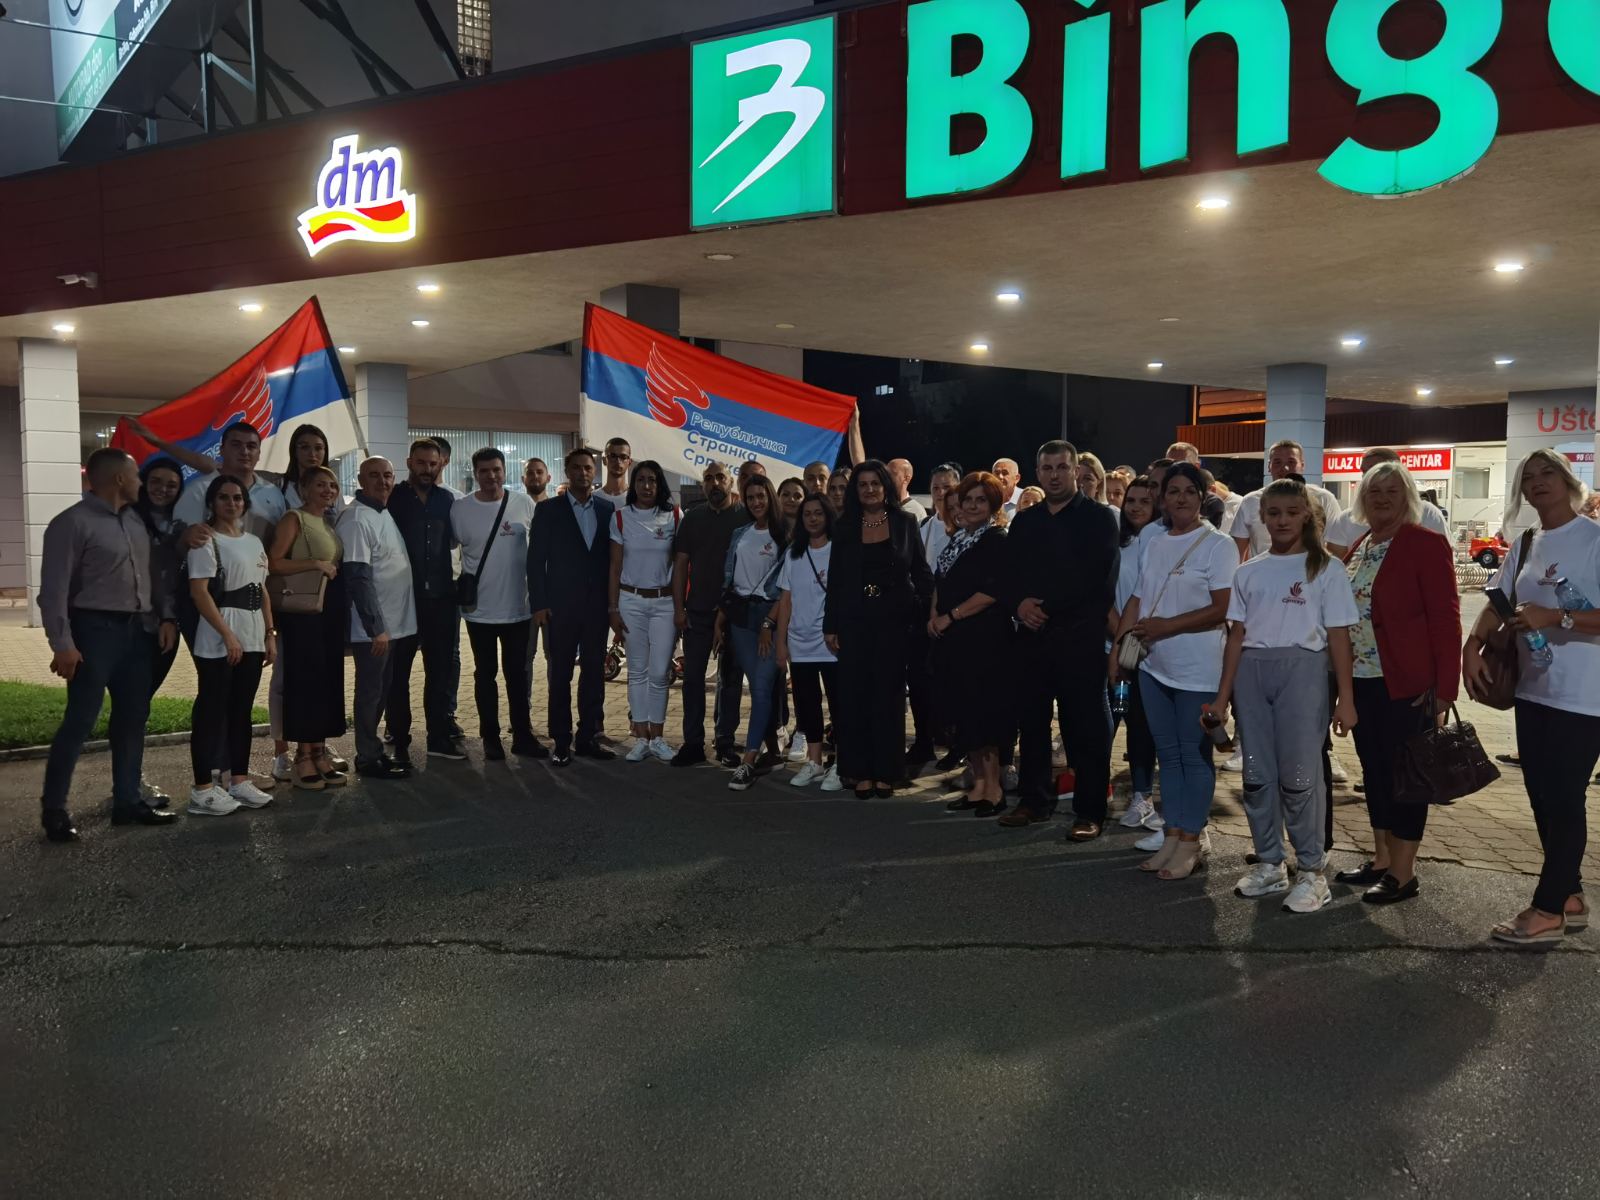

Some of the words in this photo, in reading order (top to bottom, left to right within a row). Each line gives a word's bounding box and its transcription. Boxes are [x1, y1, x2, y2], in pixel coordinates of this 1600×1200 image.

[323, 145, 395, 208] dm
[687, 430, 757, 462] Странка
[690, 411, 788, 455] Републичка
[1327, 456, 1353, 470] ULAZ
[1400, 453, 1442, 468] CENTAR
